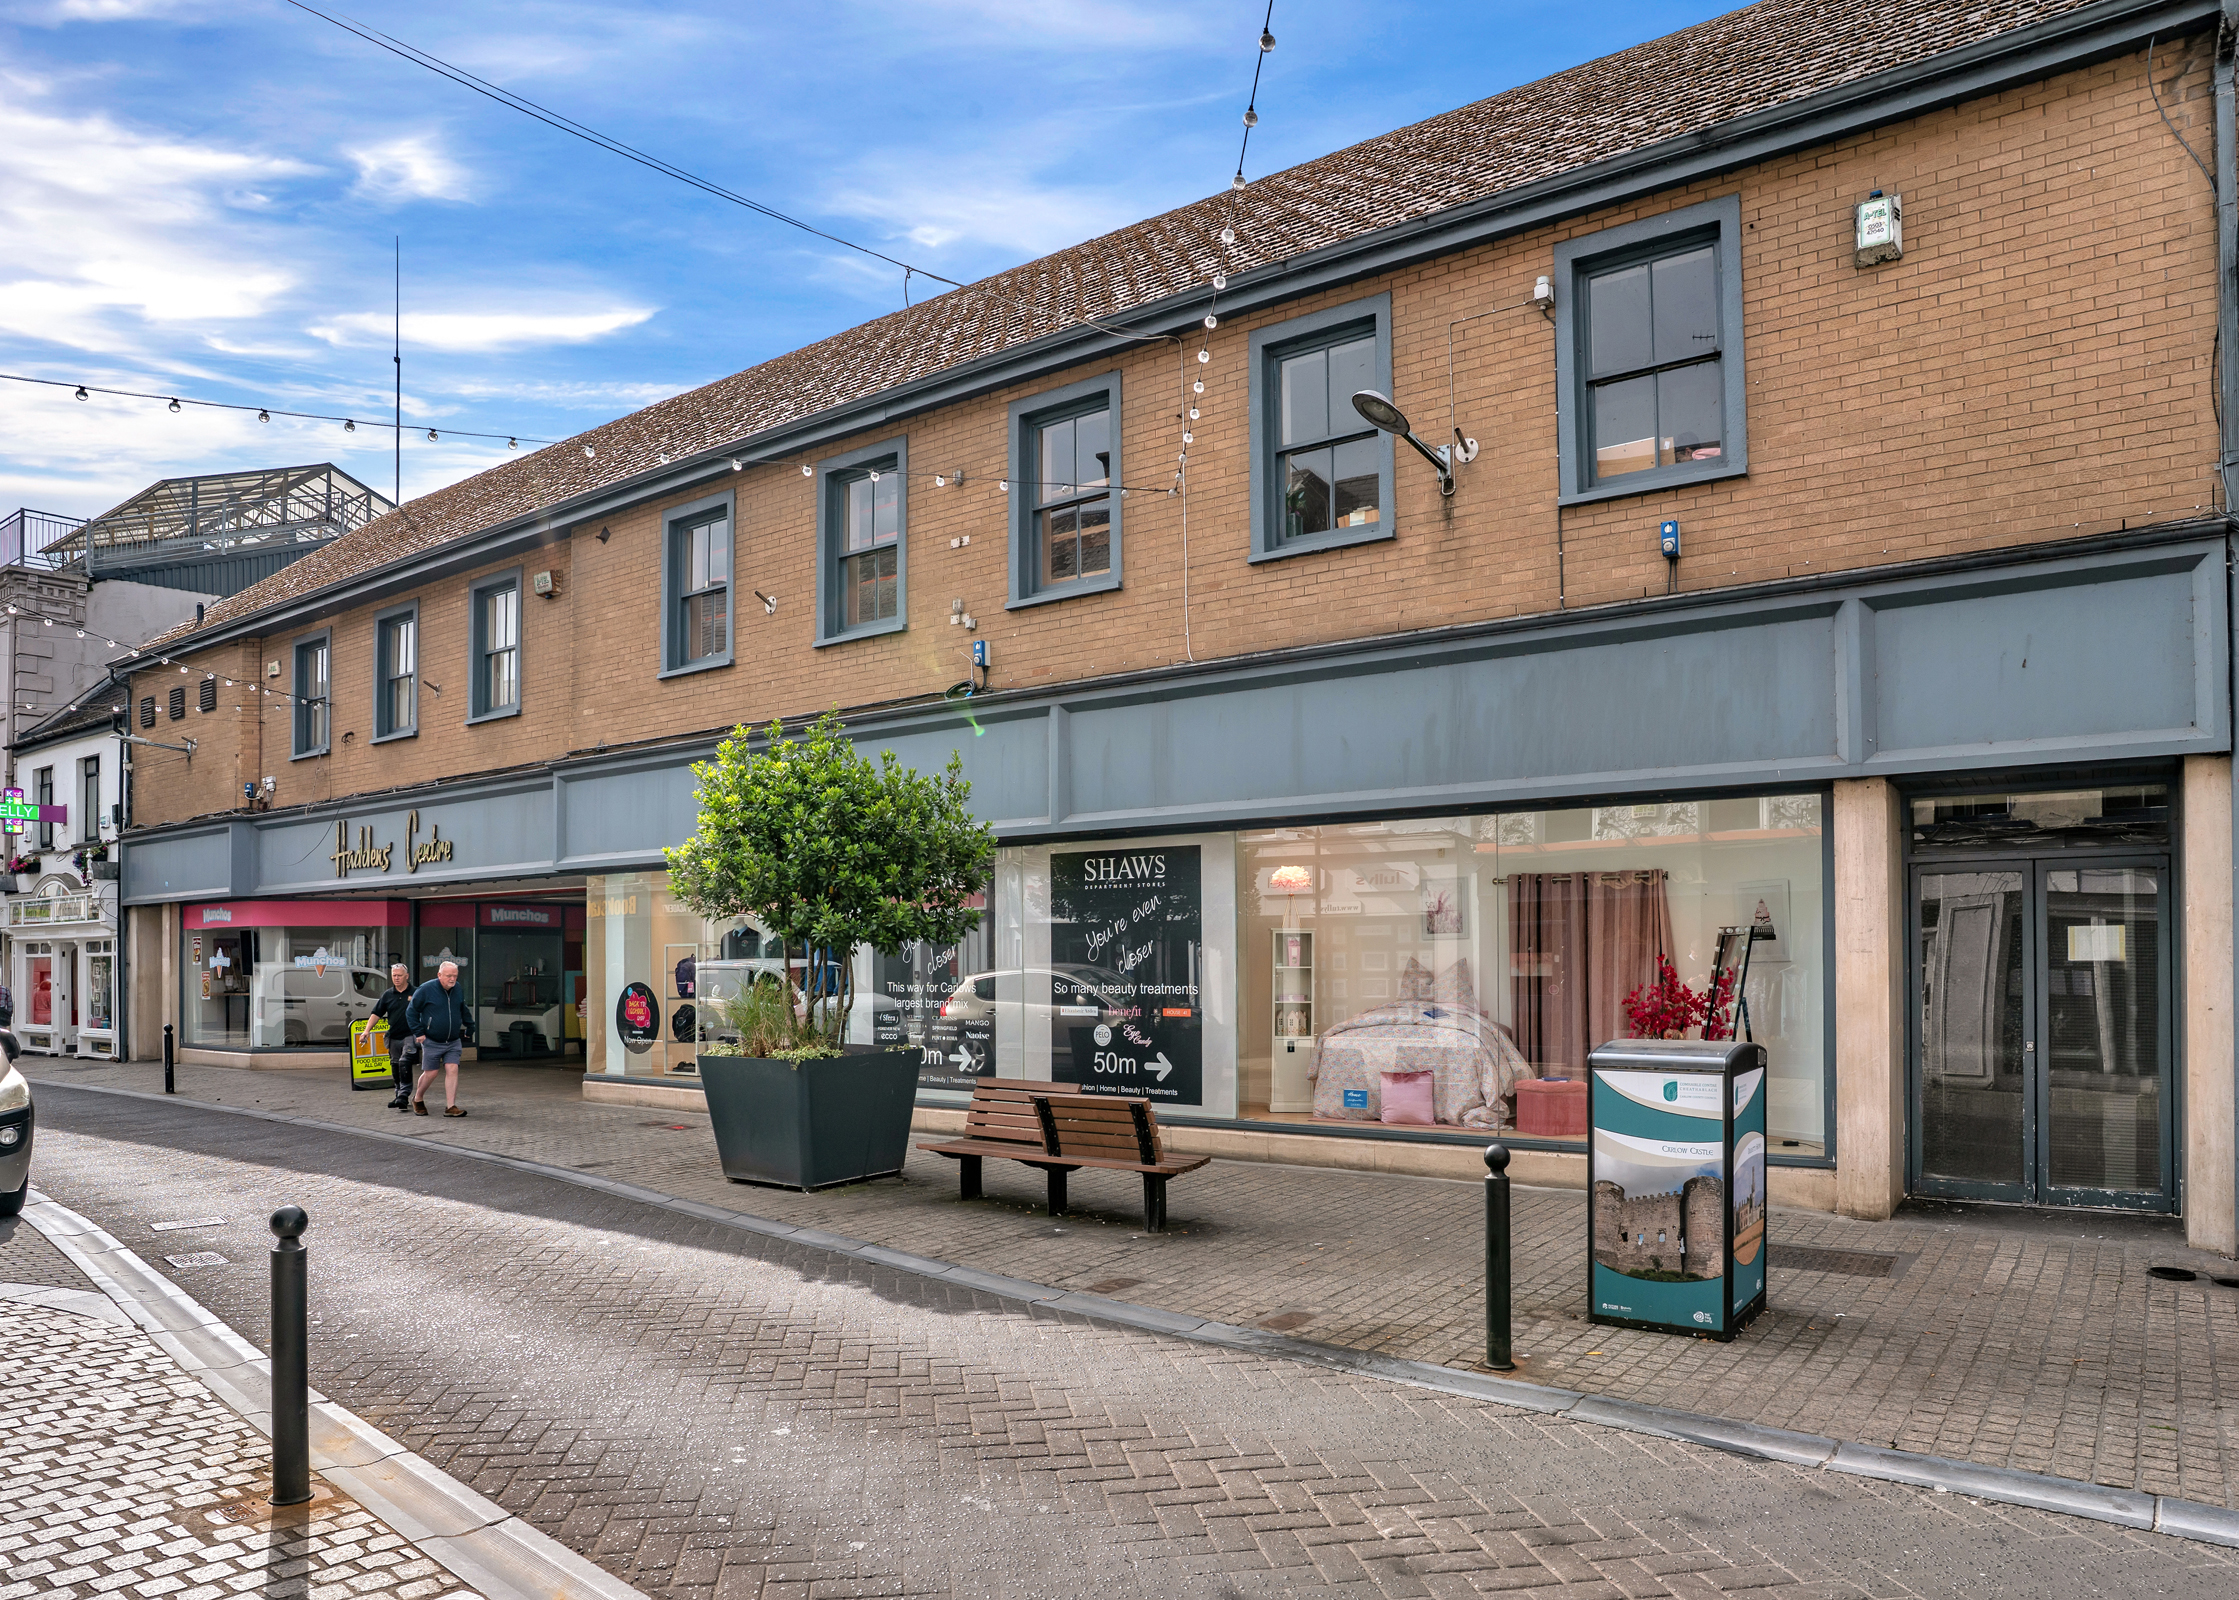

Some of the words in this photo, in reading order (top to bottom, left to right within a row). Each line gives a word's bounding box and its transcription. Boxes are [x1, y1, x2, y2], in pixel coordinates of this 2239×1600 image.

[0, 805, 34, 818] ELLY
[405, 810, 453, 873] Centre
[1084, 855, 1166, 881] SHAWS
[203, 907, 232, 924] Munchos
[491, 908, 549, 923] Munchos
[1085, 918, 1128, 961] You're
[1132, 895, 1162, 922] even
[295, 956, 347, 968] Munchos
[927, 944, 957, 975] closer
[1118, 940, 1154, 974] closer
[887, 982, 905, 993] This
[906, 985, 924, 995] way
[926, 982, 939, 993] for
[940, 982, 977, 993] Carlows
[1054, 982, 1068, 994] So
[1070, 985, 1099, 997] many
[1101, 983, 1137, 997] beauty
[1140, 983, 1199, 995] treatments
[894, 996, 923, 1010] largest
[925, 997, 951, 1008] brand
[952, 999, 969, 1009] mix
[1108, 1005, 1142, 1019] benefit
[965, 1030, 990, 1040] Naoise
[1093, 1051, 1137, 1074] 50m
[929, 1075, 946, 1083] Beauty
[950, 1076, 977, 1084] Treatments
[1099, 1084, 1117, 1092] Home
[1120, 1086, 1141, 1095] Beauty
[1145, 1087, 1178, 1096] Treatments
